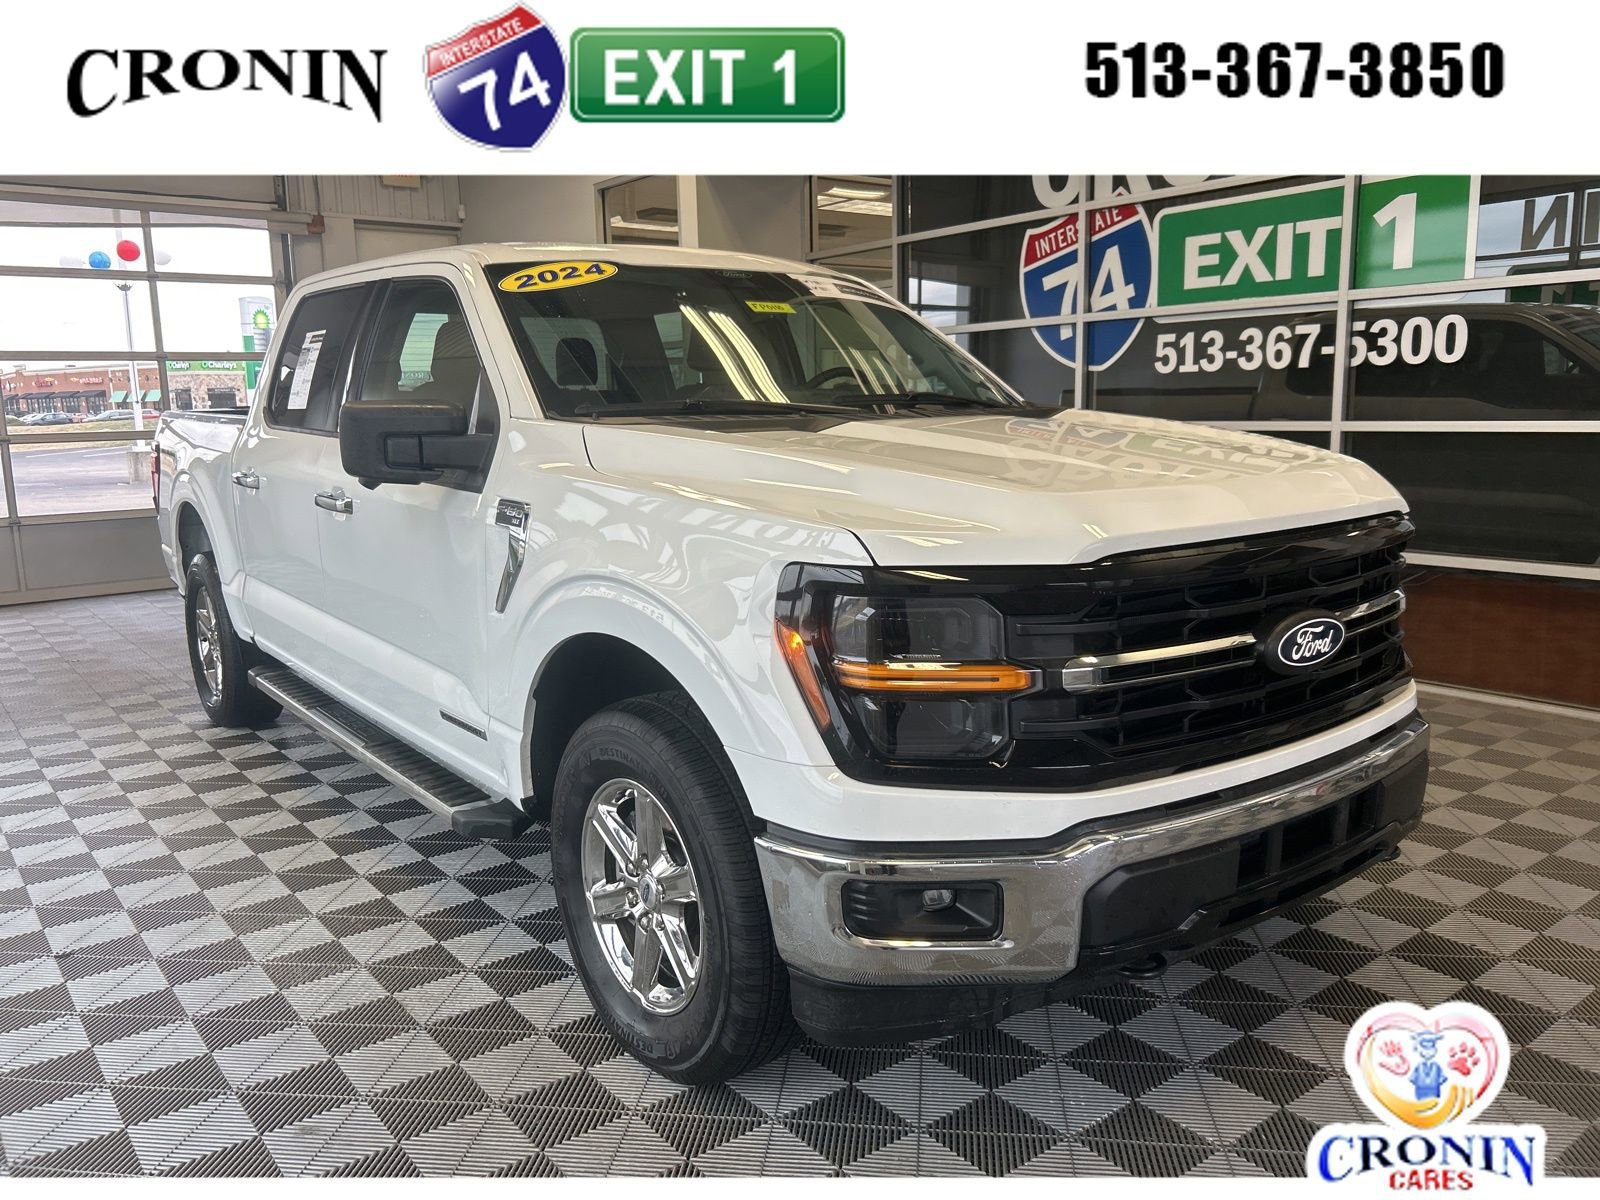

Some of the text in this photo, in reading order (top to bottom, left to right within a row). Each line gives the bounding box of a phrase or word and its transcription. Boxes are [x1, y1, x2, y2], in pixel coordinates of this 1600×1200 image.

[1034, 207, 1124, 259] INTERATE
[1183, 192, 1418, 291] EXIT 1
[514, 263, 606, 290] 2024
[1042, 244, 1136, 341] 74
[1154, 314, 1469, 374] 513-367-5300
[1291, 625, 1334, 660] Ford
